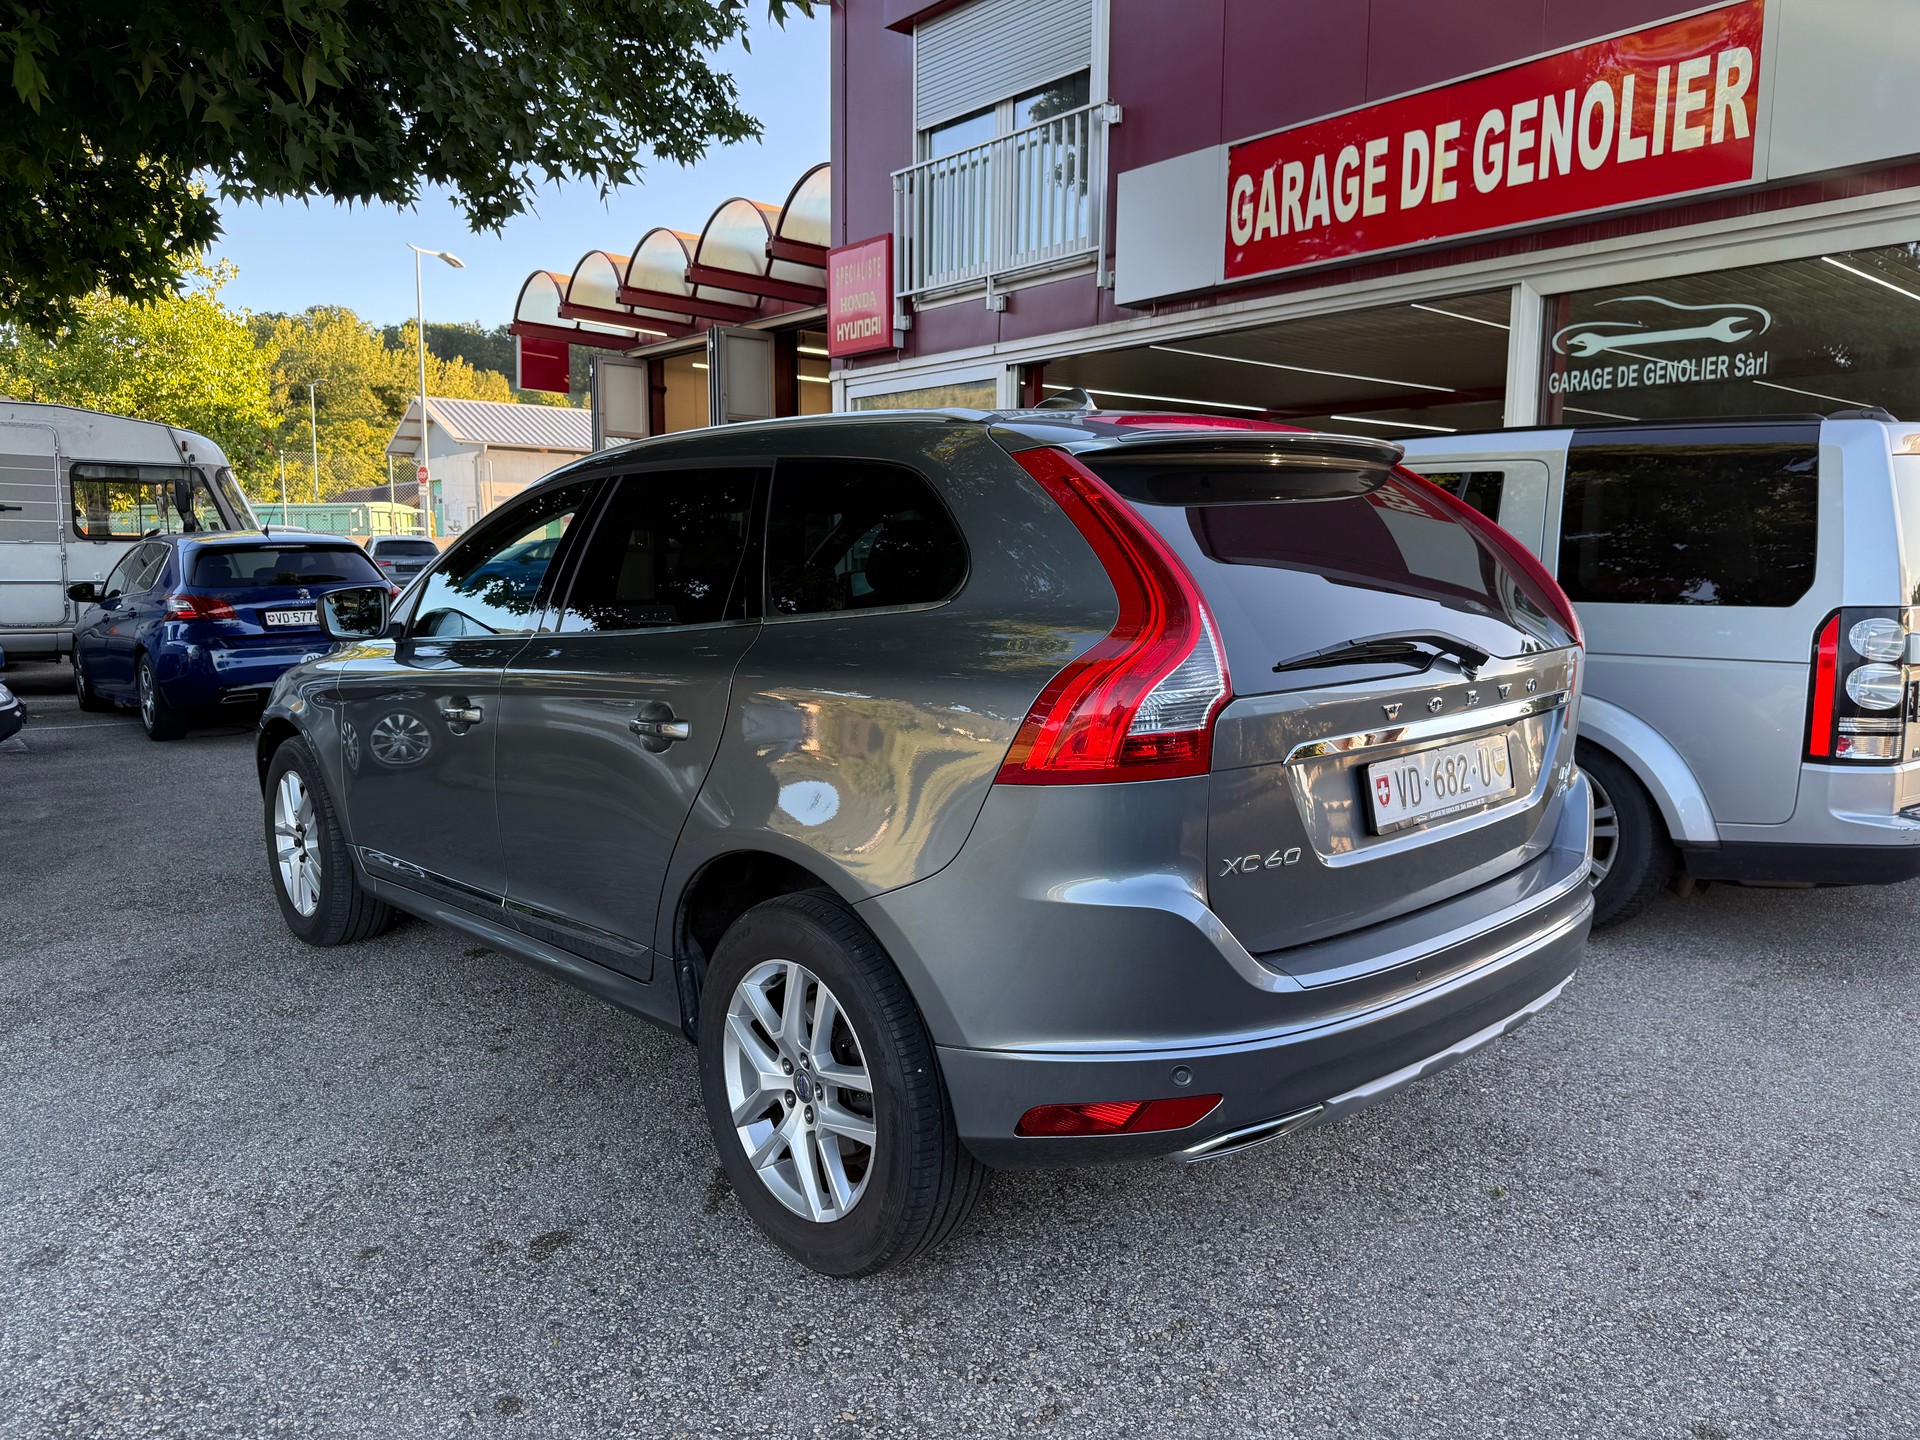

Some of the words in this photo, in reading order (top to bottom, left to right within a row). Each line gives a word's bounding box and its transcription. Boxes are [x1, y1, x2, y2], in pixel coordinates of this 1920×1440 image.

[1230, 137, 1388, 247] GARAGE
[1400, 120, 1461, 209] DE
[1473, 46, 1753, 193] GENOLIER
[840, 290, 877, 313] HONDA
[837, 316, 881, 342] HYUNDAI
[1549, 366, 1612, 394] GARAGE
[1617, 364, 1639, 388] DE
[1643, 355, 1729, 386] GENOLIER
[1734, 351, 1768, 377] Sàrl
[1382, 678, 1537, 721] VOLVO
[1219, 847, 1301, 877] XC60
